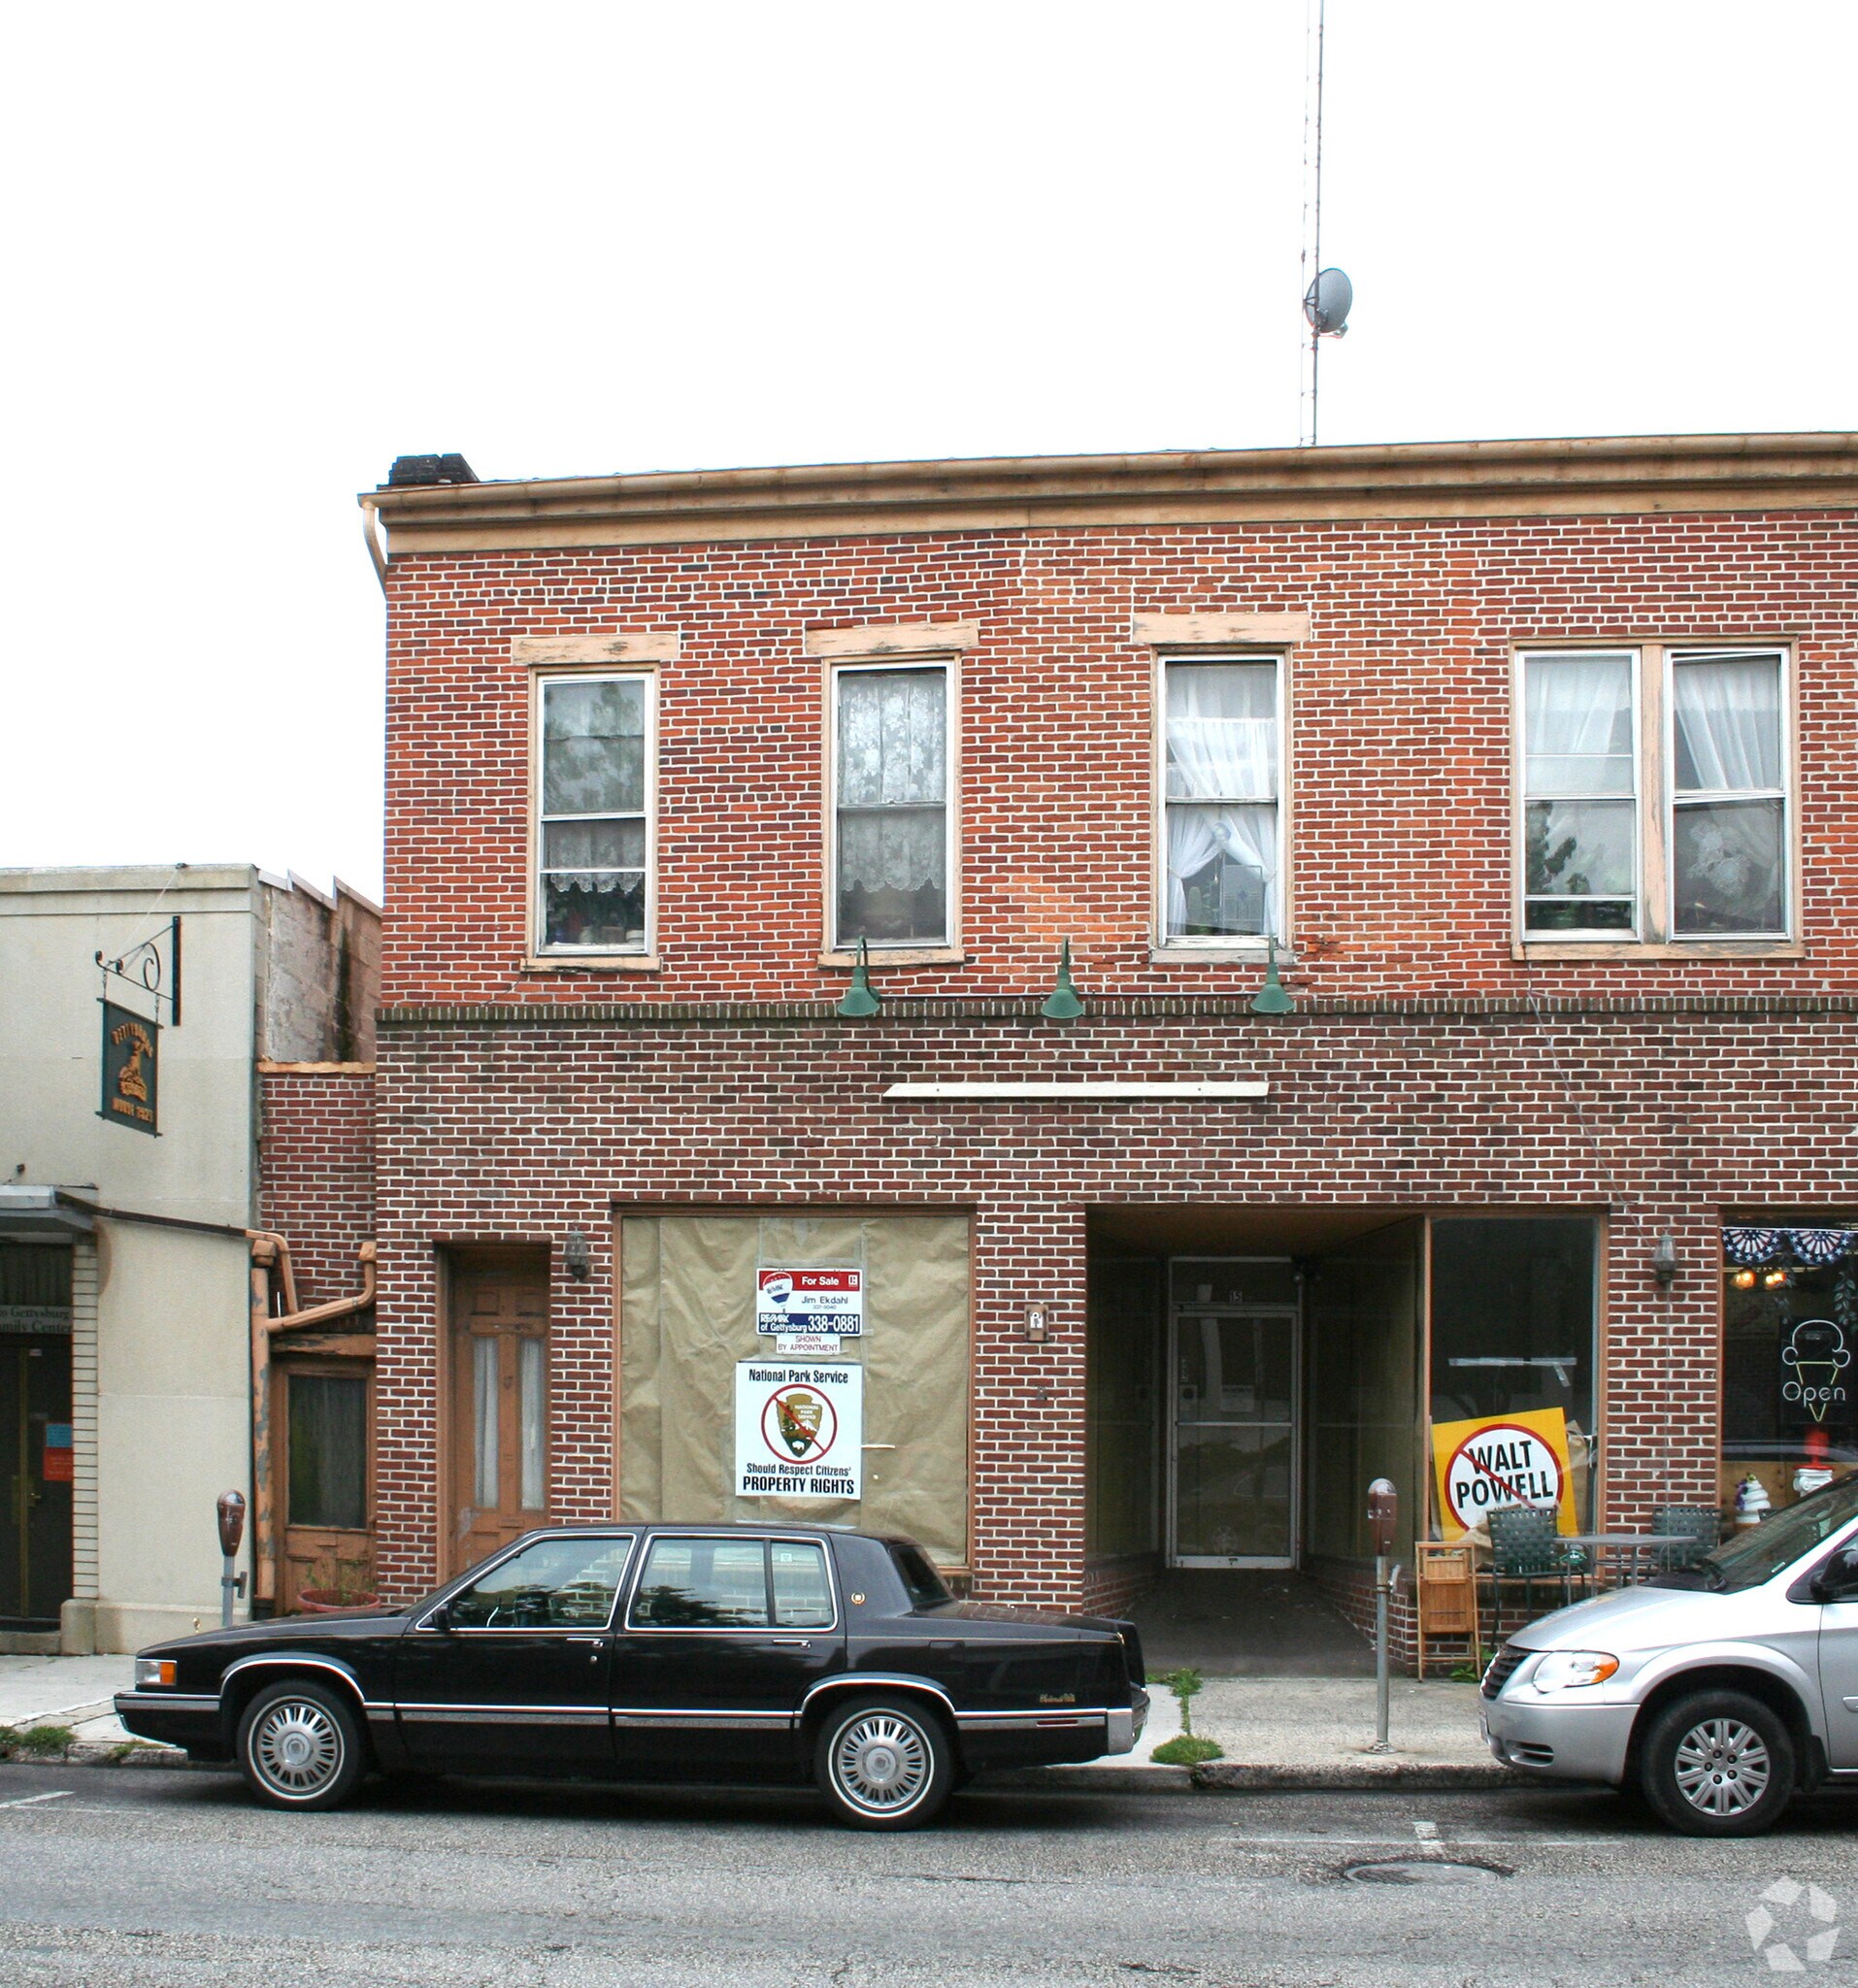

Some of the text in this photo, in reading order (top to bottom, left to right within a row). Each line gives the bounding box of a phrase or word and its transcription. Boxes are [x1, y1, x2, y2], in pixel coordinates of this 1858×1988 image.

[802, 1276, 839, 1285] For Sale
[819, 1296, 848, 1305] Ekdahl
[760, 1314, 790, 1323] RE/MAX
[808, 1315, 859, 1333] 338-0881
[770, 1323, 808, 1334] Gettysburg
[748, 1369, 848, 1384] National Park Service
[1782, 1381, 1846, 1408] Open
[1469, 1441, 1532, 1474] WALT
[747, 1463, 851, 1476] Should Respect Citizens'
[743, 1475, 854, 1495] PROPERTY RIGHTS
[1456, 1471, 1554, 1508] POWELL
